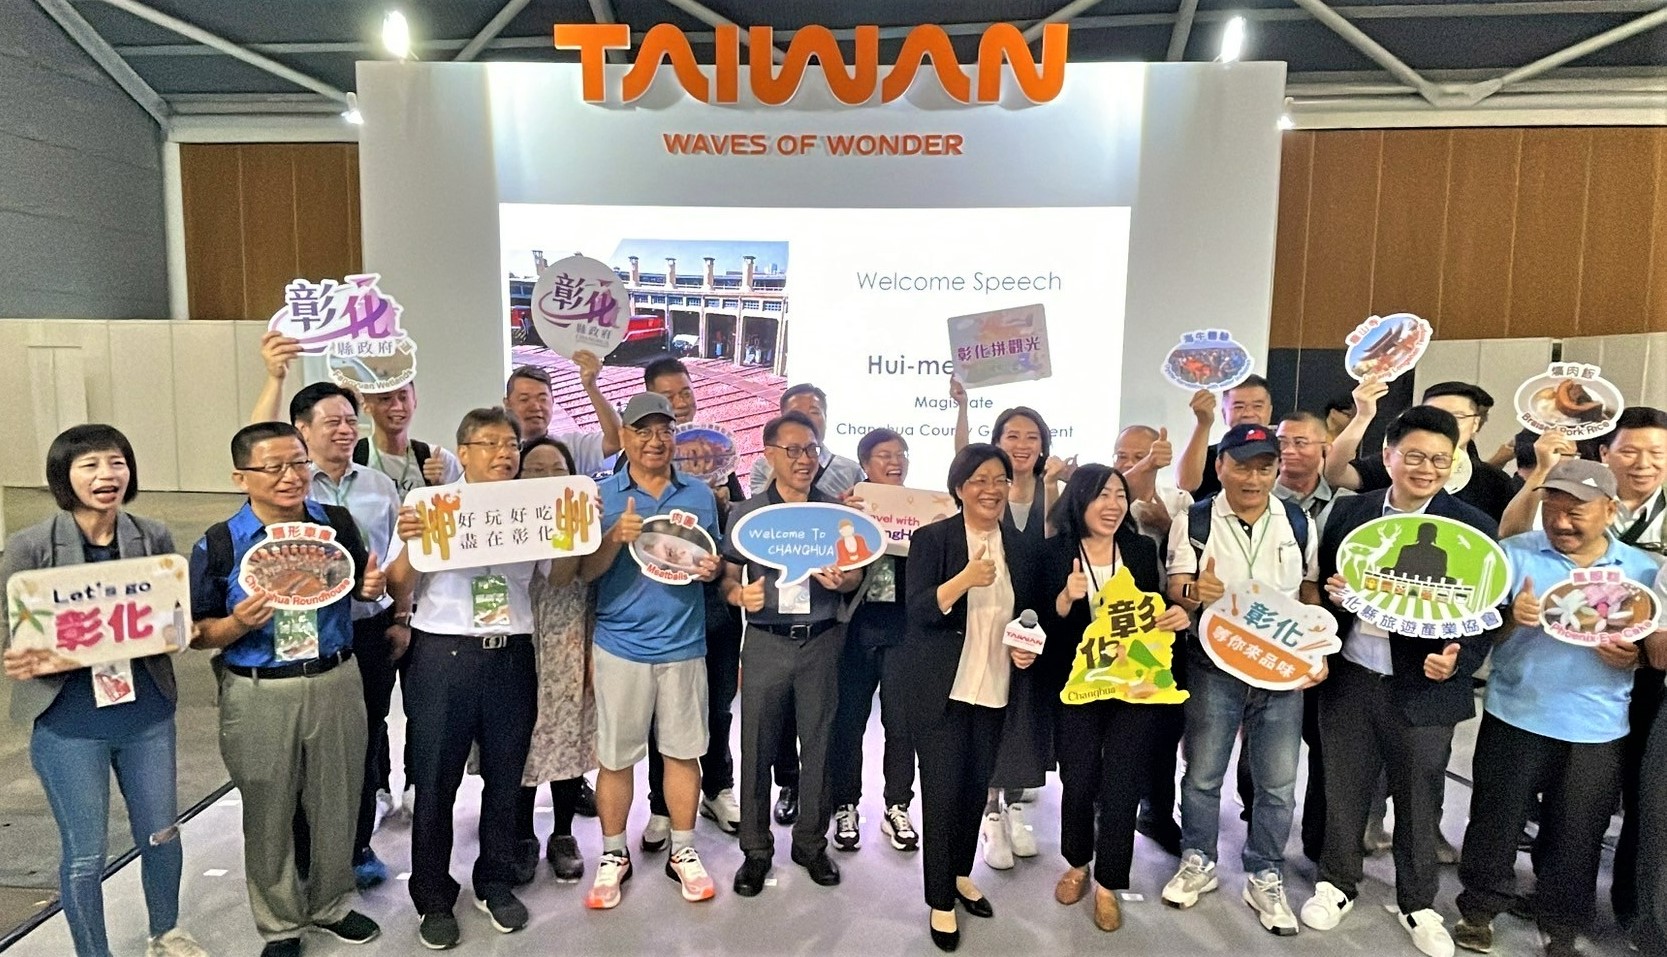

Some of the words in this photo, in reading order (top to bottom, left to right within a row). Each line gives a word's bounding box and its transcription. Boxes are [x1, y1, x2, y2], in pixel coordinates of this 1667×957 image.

[554, 23, 1069, 105] TAIWAN
[663, 134, 767, 156] WAVES
[777, 134, 816, 156] OF
[827, 134, 964, 156] WONDER
[856, 271, 966, 292] Welcome
[973, 271, 1062, 294] Speech
[288, 282, 391, 340] 彰化
[552, 272, 617, 327] 彰化
[337, 340, 393, 356] 縣政府
[957, 336, 1041, 361] 彰化拼觀光
[868, 354, 954, 376] Hui-me
[914, 396, 994, 411] Magisate
[1586, 420, 1611, 435] Rice
[458, 504, 554, 529] 好玩好吃
[896, 515, 920, 527] with
[460, 525, 554, 550] 盡在彰化
[749, 527, 806, 541] Welcome
[812, 527, 826, 540] To
[768, 543, 835, 557] CHANGHUA
[646, 562, 689, 581] Meatballs
[53, 581, 117, 604] Let's
[291, 578, 351, 606] Roundhouse
[1242, 600, 1305, 648] 彰化
[1332, 588, 1500, 638] 化縣旅遊產業協會
[55, 601, 154, 652] 彰化
[1006, 631, 1043, 646] TAIWAN
[1212, 624, 1297, 678] 等你來品味
[1067, 687, 1117, 702] Changhua
